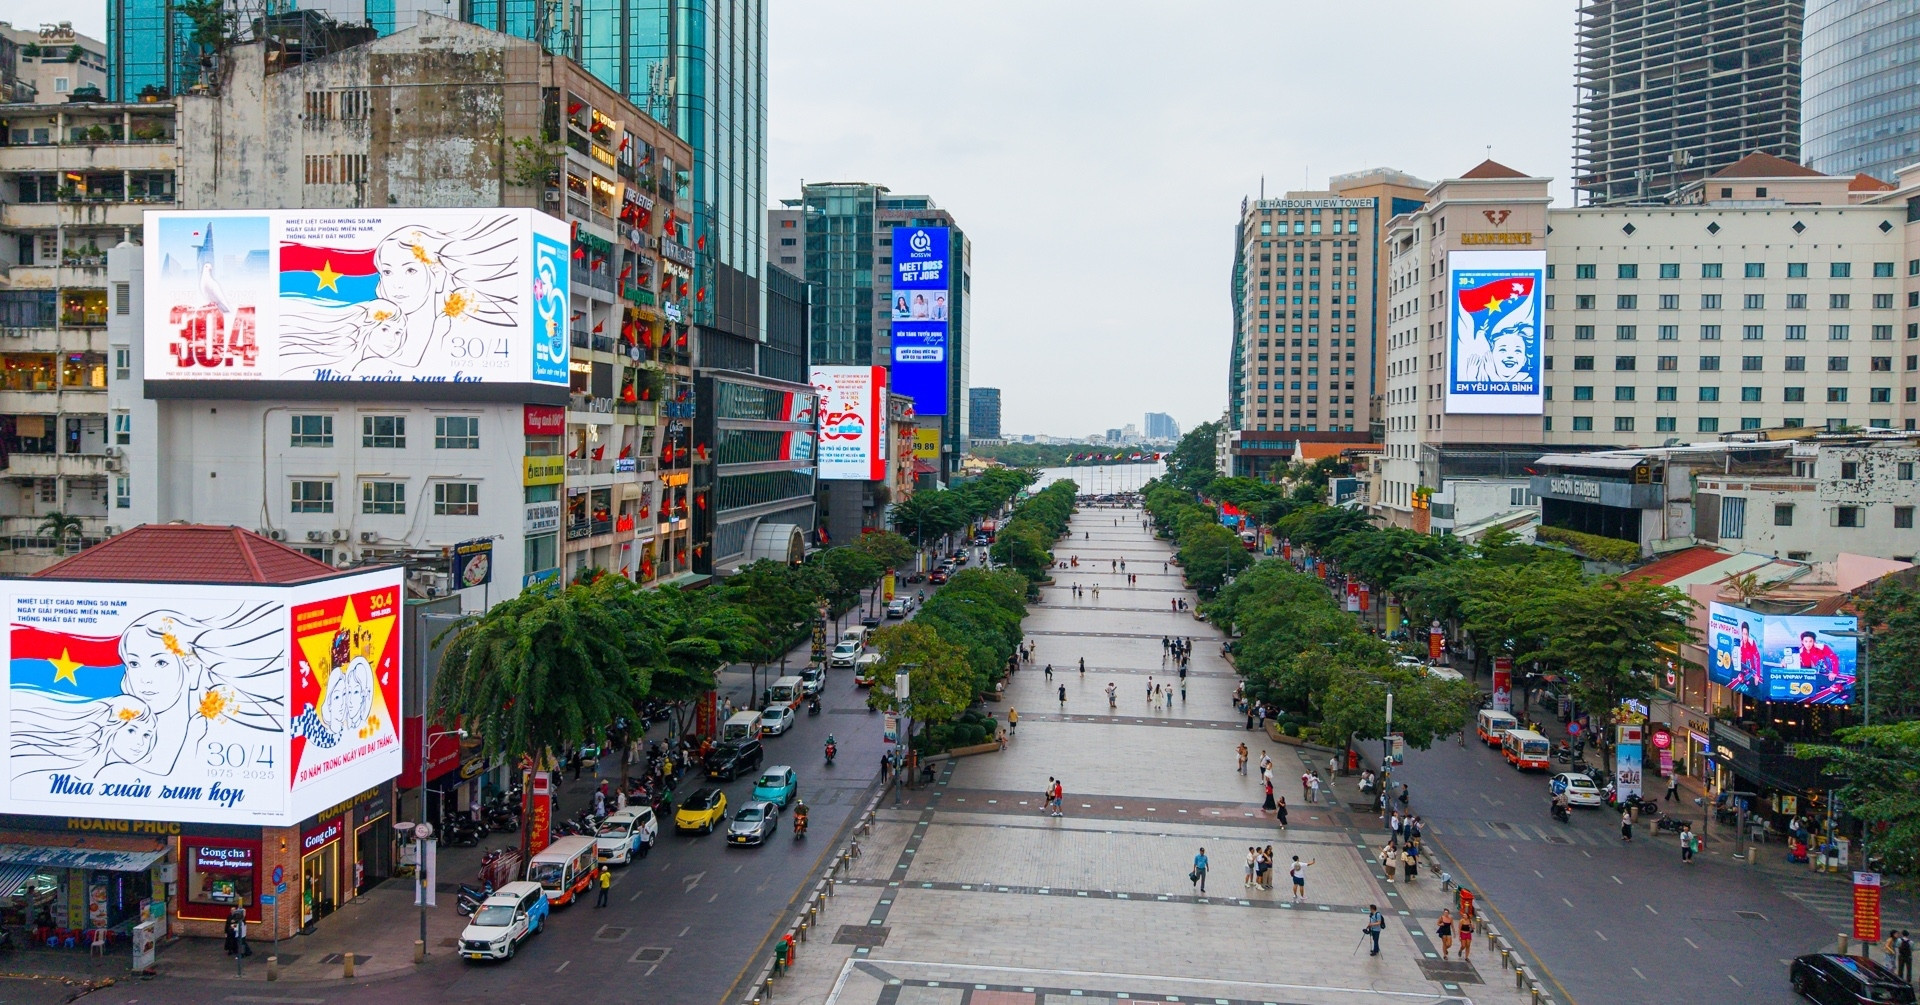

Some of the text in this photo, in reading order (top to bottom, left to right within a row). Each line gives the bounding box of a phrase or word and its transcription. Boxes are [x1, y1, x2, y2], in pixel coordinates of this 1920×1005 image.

[1461, 232, 1532, 245] SAIGON PRINCE
[900, 260, 943, 272] MEET BOSS
[902, 270, 939, 282] GET JOBS
[451, 336, 509, 359] 30/4
[1456, 382, 1533, 392] EM YÊU HOÀ BÌNH
[1551, 480, 1600, 498] SAIGON GARDEN
[370, 592, 392, 610] 30.4
[207, 742, 274, 769] 30/4
[207, 769, 275, 780] 1975 2025
[300, 771, 307, 782] 50
[323, 756, 341, 773] TRONG
[49, 773, 244, 808] Mùa xuân sum họp
[305, 826, 337, 848] Gong cha
[201, 847, 244, 859] Gong cha
[199, 859, 223, 867] Brewing
